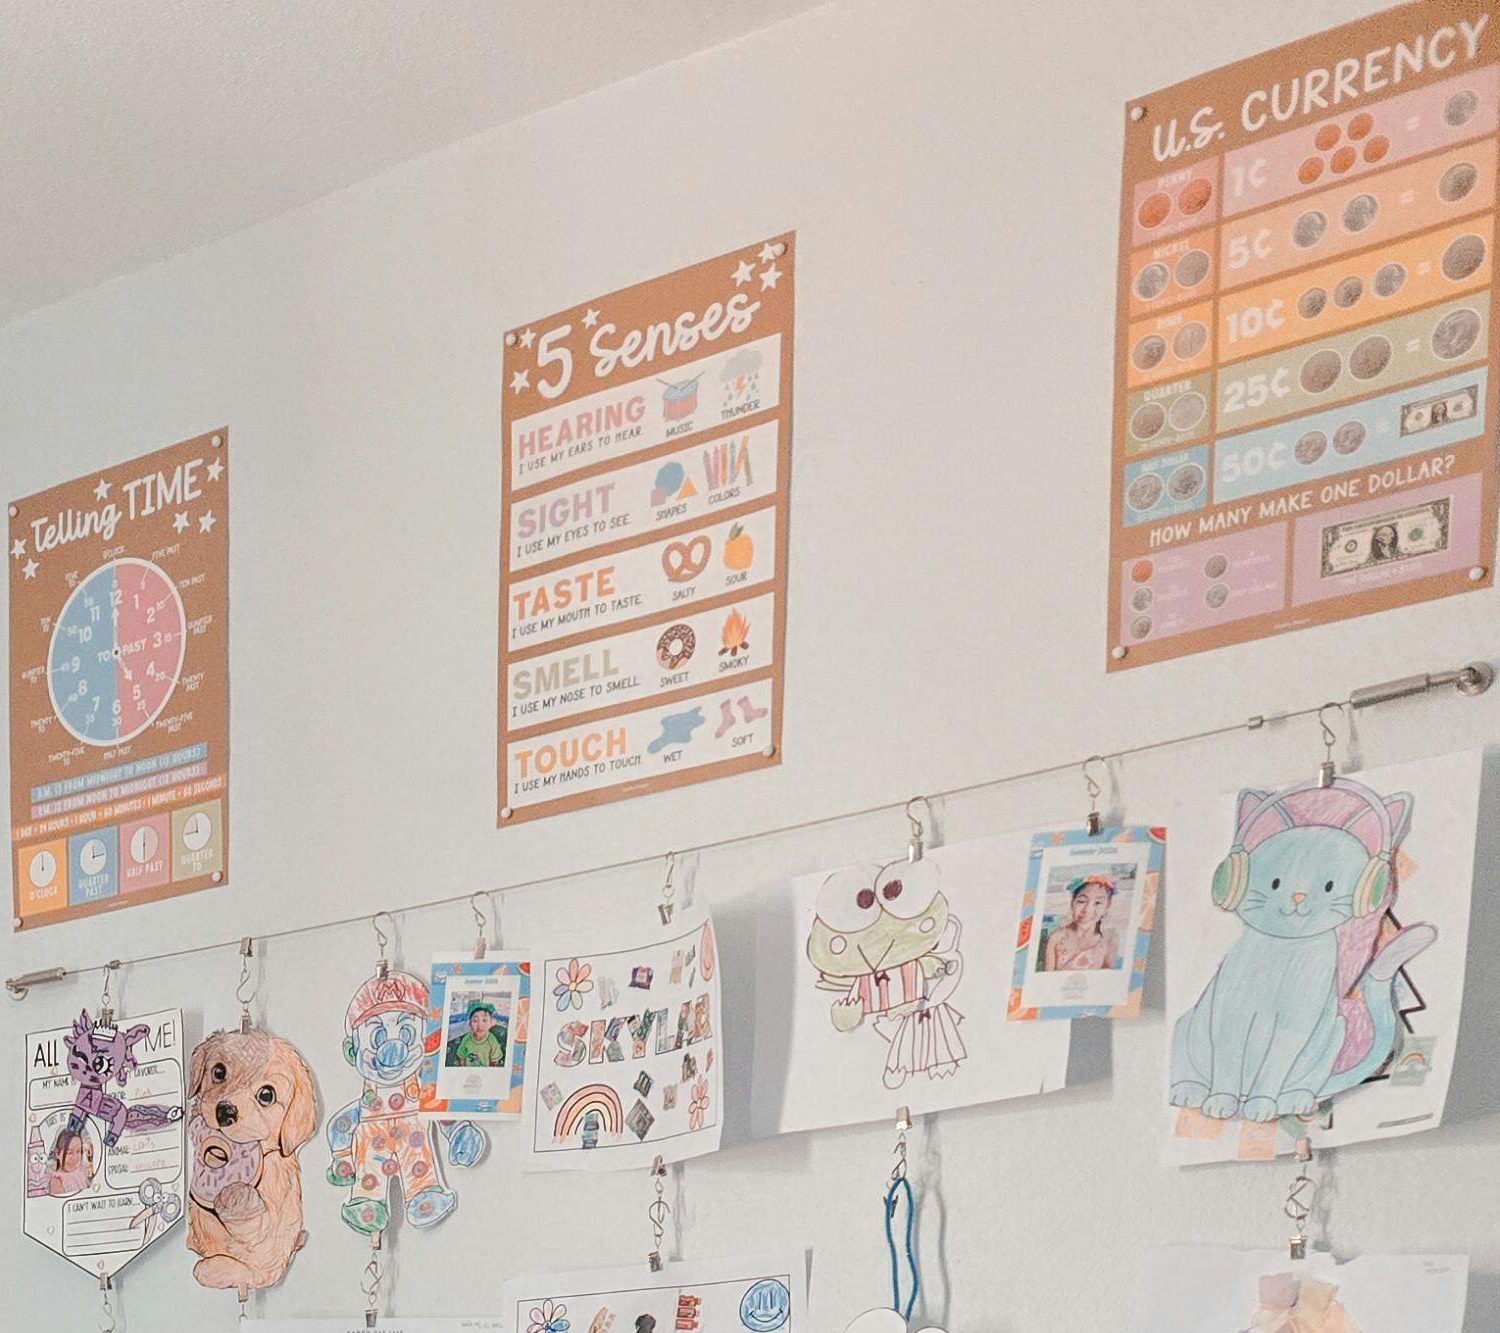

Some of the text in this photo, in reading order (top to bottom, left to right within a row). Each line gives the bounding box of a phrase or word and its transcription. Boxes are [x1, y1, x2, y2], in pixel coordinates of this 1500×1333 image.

[1153, 13, 1490, 162] U.S. CURRENCY
[536, 292, 761, 398] 5 Senses
[517, 395, 646, 460] HEARING
[528, 458, 547, 472] USE
[550, 452, 564, 466] MY
[567, 441, 593, 458] EARS
[598, 437, 611, 449] TO
[30, 458, 204, 554] Telling TIME
[517, 484, 616, 539] SIGHT
[1149, 454, 1457, 548] HOW MANY MAKE ONE DOLLAR?
[525, 521, 606, 555] USE MY EYES TO
[513, 565, 616, 621] TASTE
[672, 586, 696, 601] SALTY
[725, 571, 748, 586] SOUR
[519, 622, 539, 637] USE
[540, 617, 556, 632] MY
[558, 607, 591, 626] MOUTH
[594, 602, 607, 615] TO
[97, 638, 148, 663] TO PAST
[718, 655, 750, 672] SMOKY
[513, 648, 620, 700] SMELL
[659, 671, 689, 688] SWEET
[520, 702, 540, 716] USE
[542, 695, 558, 710] MY
[559, 688, 586, 704] NOSE
[589, 684, 603, 696] TO
[515, 727, 628, 779] TOUCH
[663, 750, 683, 763] WET
[731, 733, 754, 748] SOFT
[521, 777, 540, 791] USE
[542, 771, 558, 787] MY
[559, 765, 590, 783] HANDS
[593, 761, 607, 774] TO
[143, 1019, 177, 1053] ME!
[33, 1039, 60, 1068] ALL
